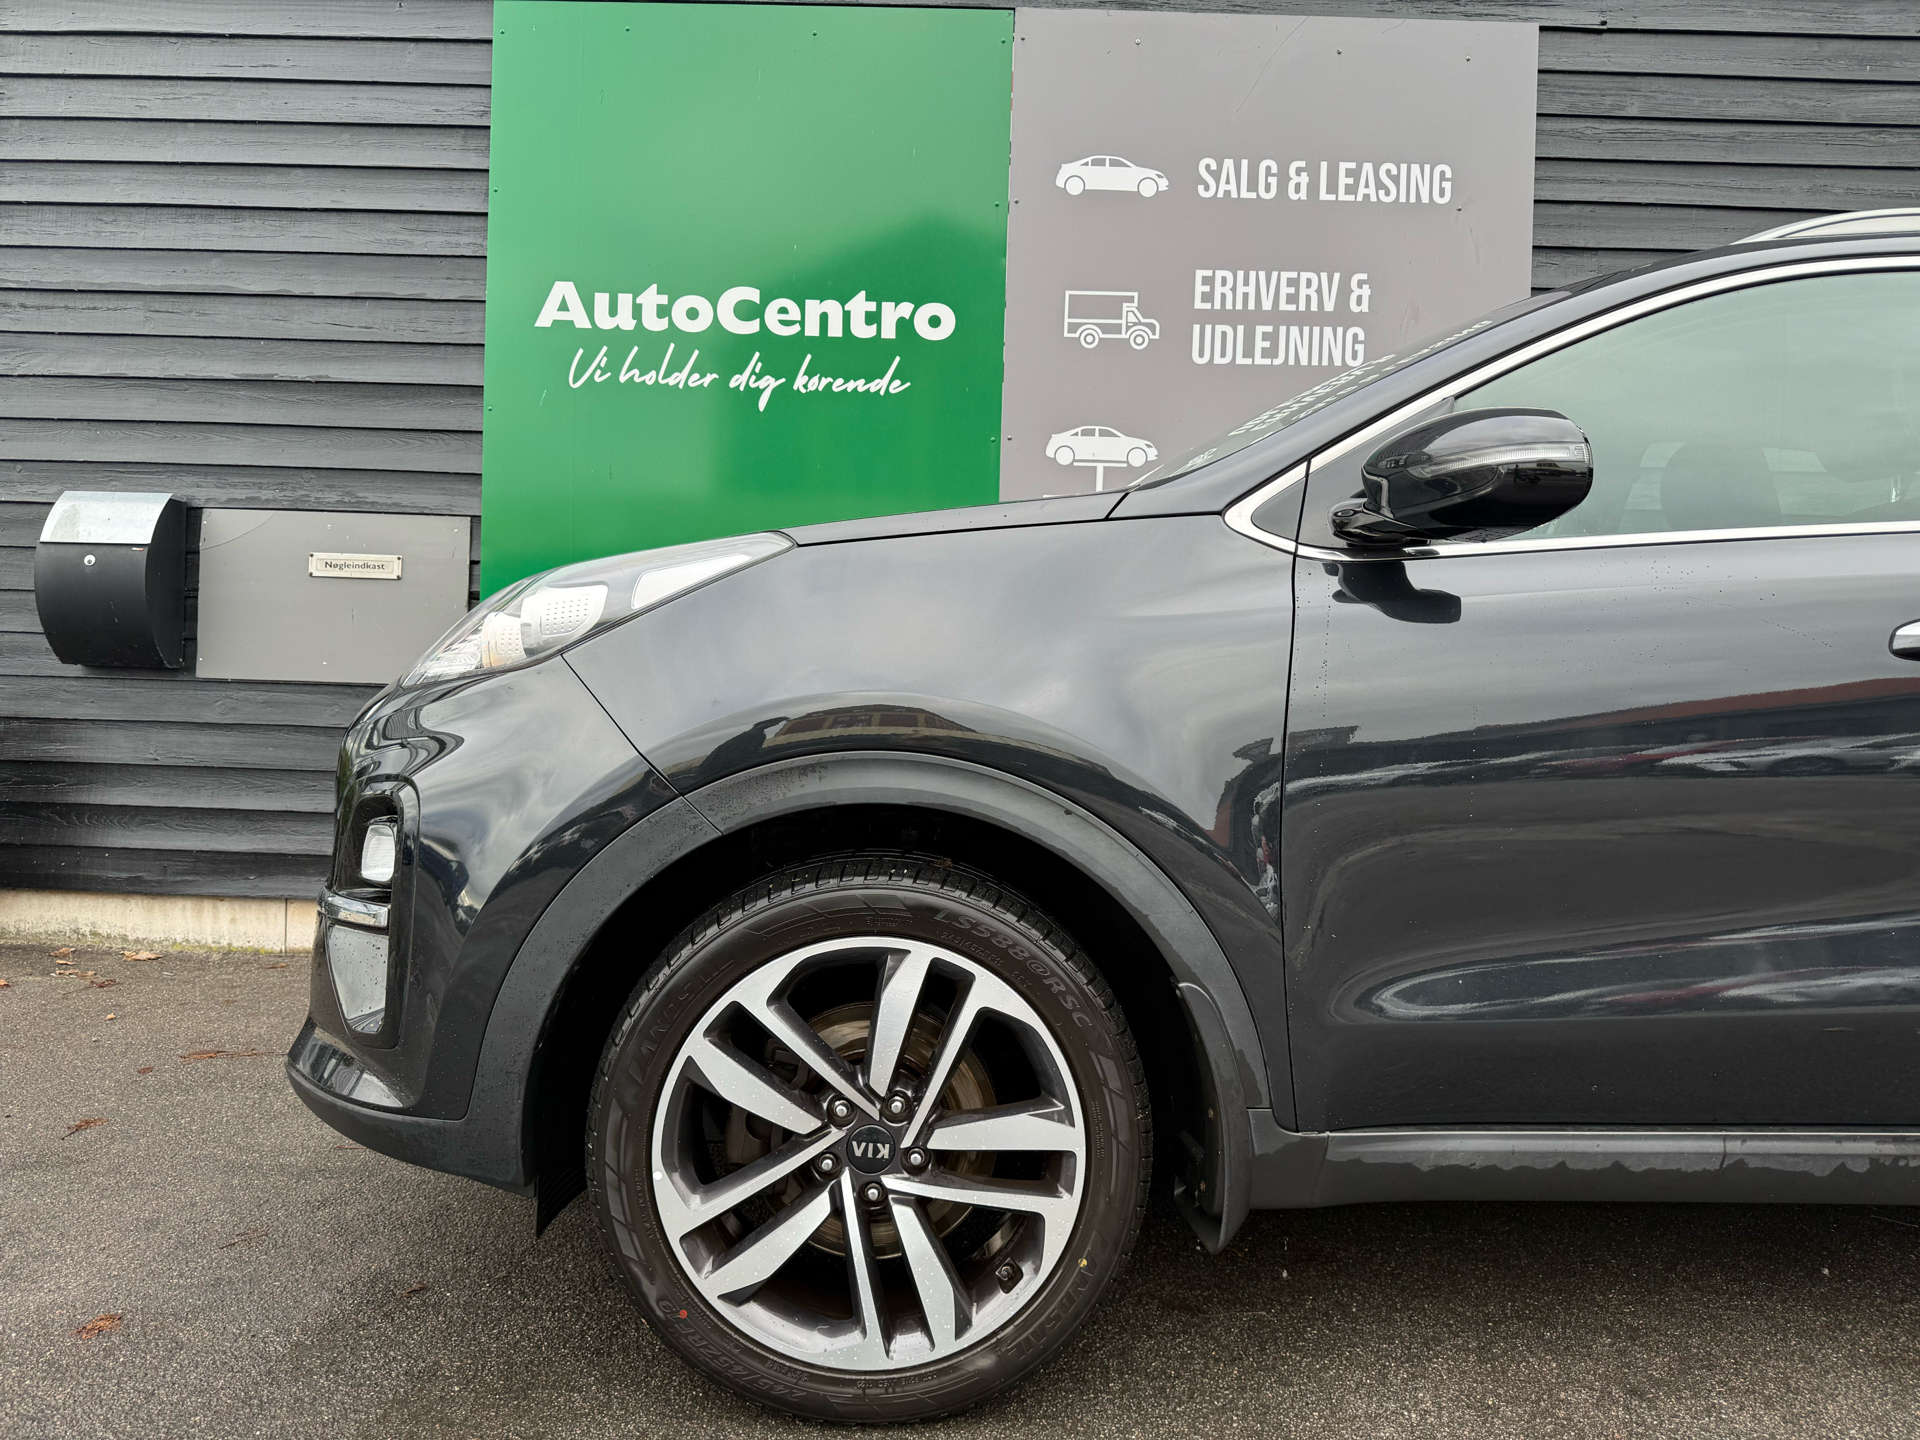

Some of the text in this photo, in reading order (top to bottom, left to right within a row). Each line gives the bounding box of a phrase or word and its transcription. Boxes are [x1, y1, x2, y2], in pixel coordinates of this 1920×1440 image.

[1198, 158, 1453, 205] SALG & LEASING
[534, 280, 957, 341] AutoCentro
[1193, 269, 1372, 313] ERHVERV &
[1192, 324, 1366, 367] UDLEJNING
[568, 343, 911, 412] Vi holder dig kørende
[324, 560, 386, 571] Nøgleindkast
[852, 1140, 890, 1159] KIA
